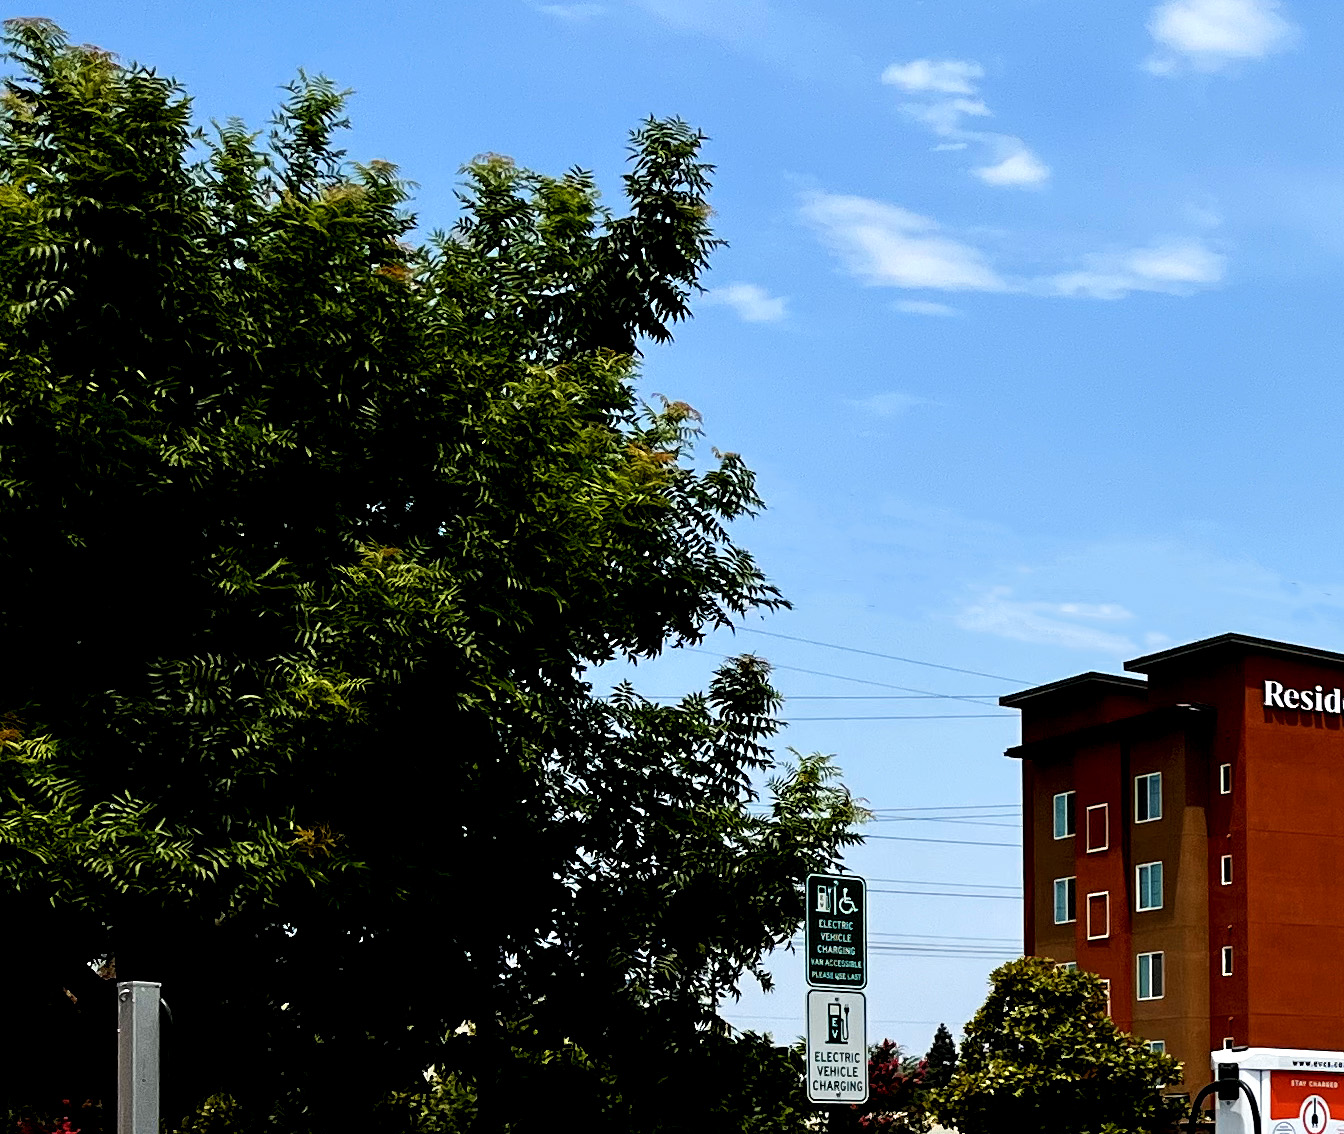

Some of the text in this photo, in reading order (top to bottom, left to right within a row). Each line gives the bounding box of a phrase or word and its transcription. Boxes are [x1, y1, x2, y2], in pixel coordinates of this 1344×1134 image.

[818, 919, 854, 930] ELECTRIC
[820, 932, 852, 943] VEHICLE
[817, 944, 856, 955] CHARGING
[814, 1051, 861, 1064] ELECTRIC
[817, 1066, 859, 1078] VEHICLE
[812, 1079, 863, 1092] CHARGING
[1291, 1079, 1307, 1087] STAY
